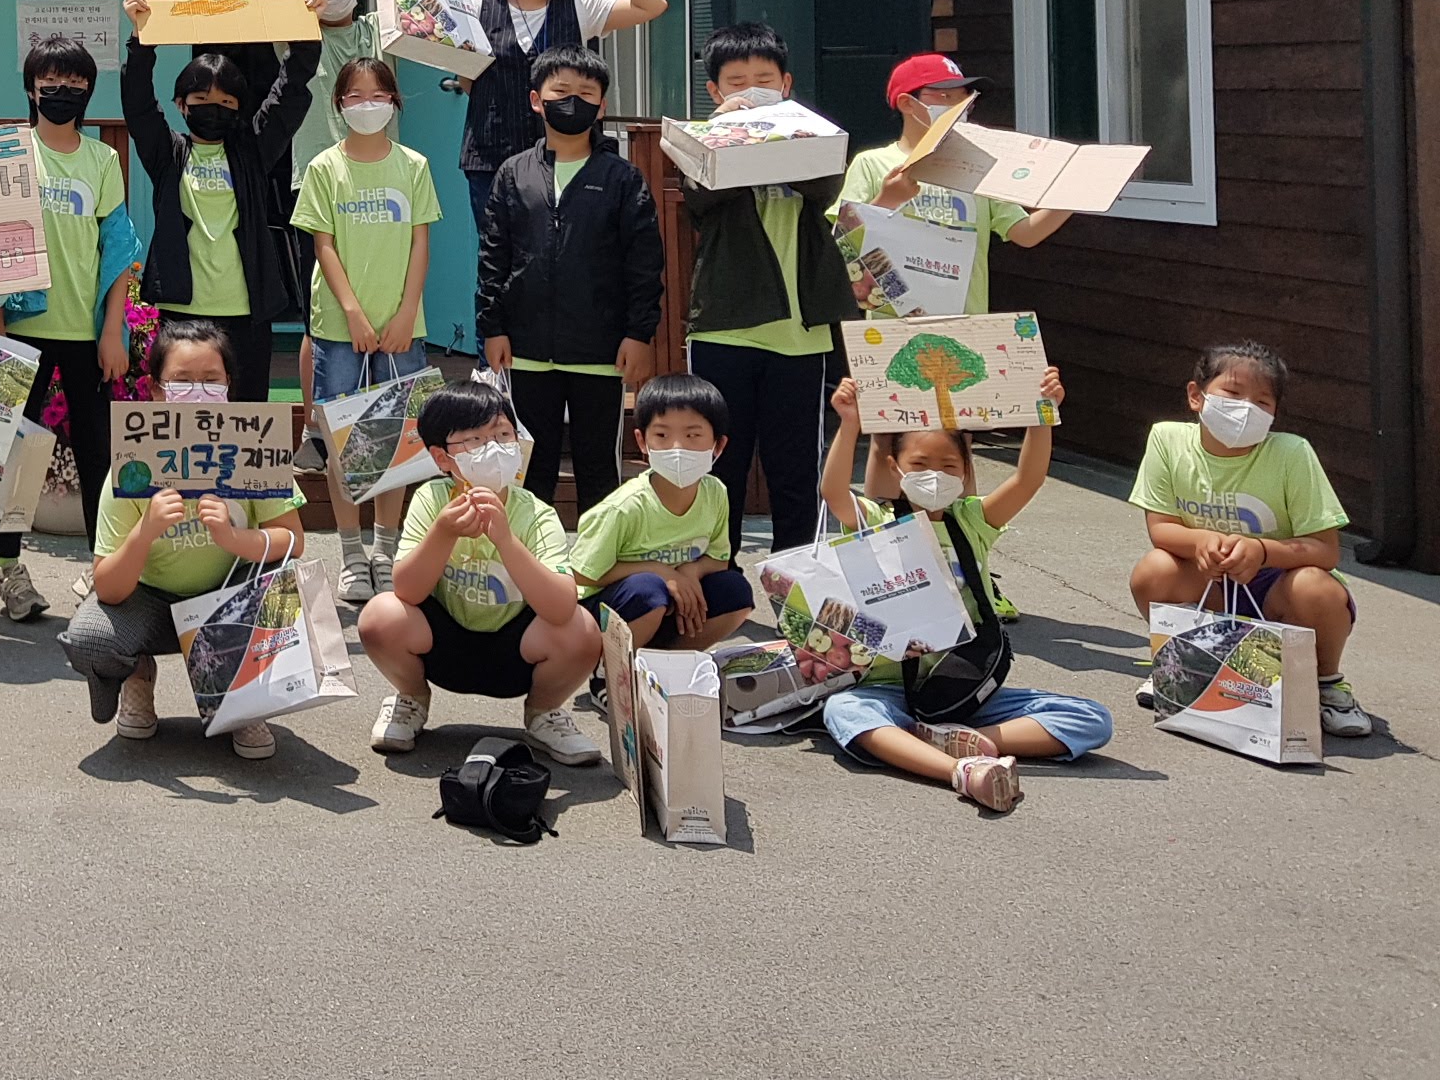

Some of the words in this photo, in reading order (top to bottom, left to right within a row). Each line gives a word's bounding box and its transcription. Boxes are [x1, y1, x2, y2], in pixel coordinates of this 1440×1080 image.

[357, 188, 385, 200] THE
[337, 199, 387, 214] NORTH
[352, 212, 388, 224] FACE
[124, 410, 182, 444] 우리
[194, 410, 274, 444] 함께!
[156, 443, 239, 490] 지구를
[1175, 496, 1238, 521] NORTH
[884, 568, 927, 591] 농특산물
